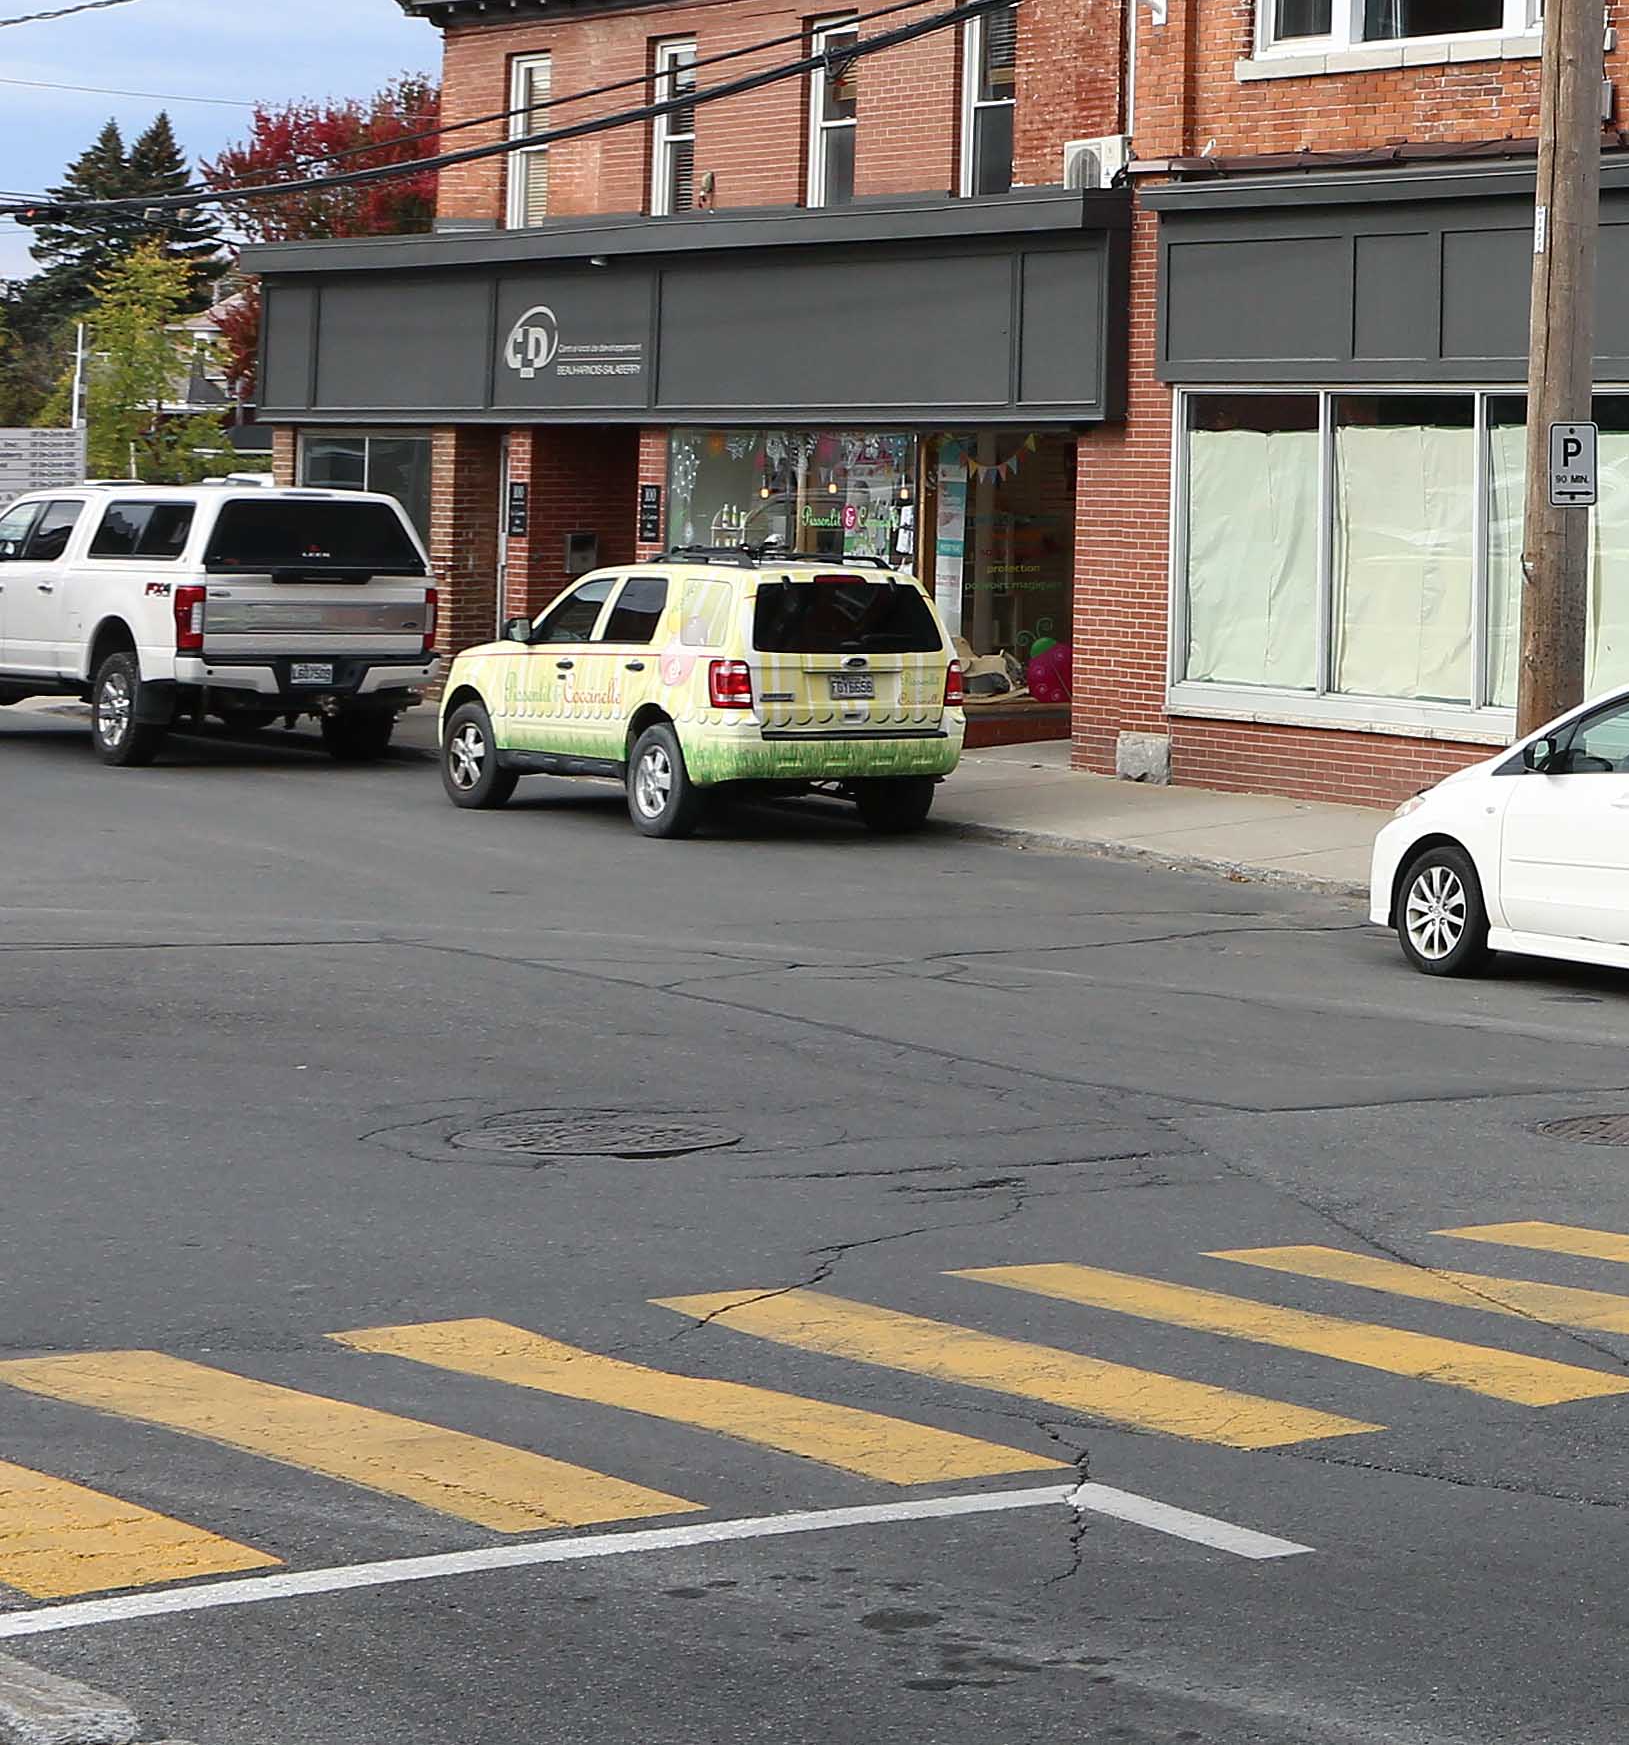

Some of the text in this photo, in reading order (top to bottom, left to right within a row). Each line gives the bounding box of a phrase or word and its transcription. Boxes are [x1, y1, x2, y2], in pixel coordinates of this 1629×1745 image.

[1563, 438, 1582, 467] P
[1555, 474, 1567, 484] 90
[145, 582, 171, 597] FX4
[563, 672, 622, 704] Coccinelle
